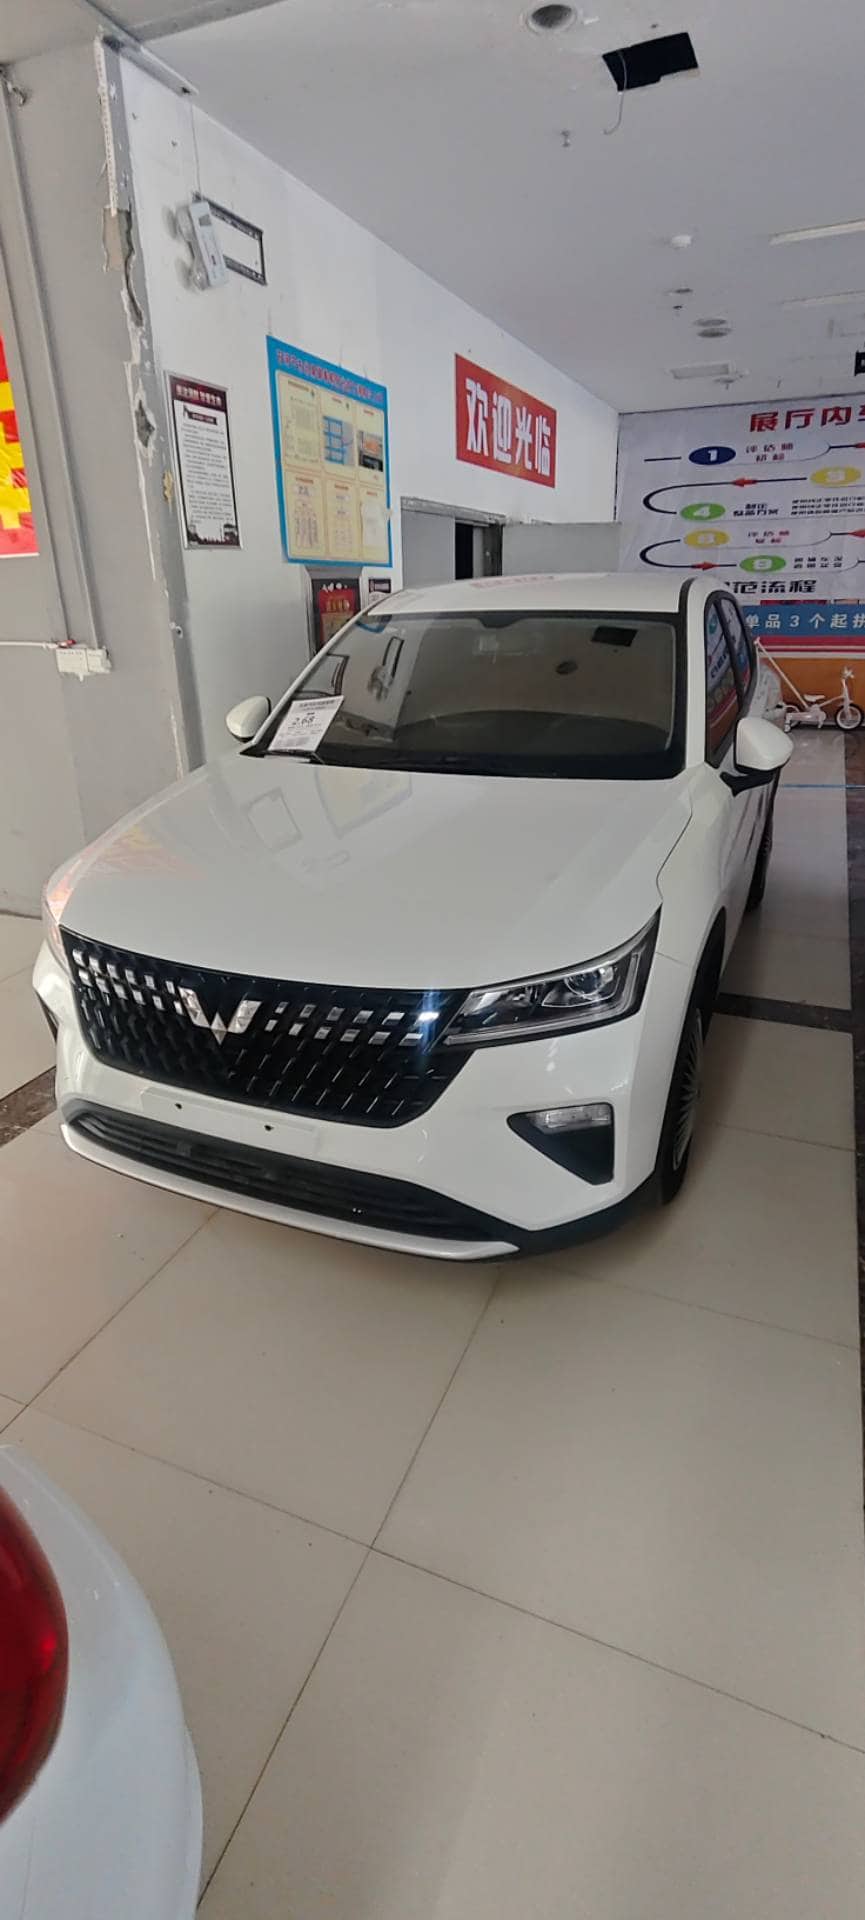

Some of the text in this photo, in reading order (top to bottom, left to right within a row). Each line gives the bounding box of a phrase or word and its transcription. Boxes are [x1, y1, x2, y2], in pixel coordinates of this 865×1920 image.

[750, 405, 865, 432] 展厅内
[465, 377, 551, 477] 欢迎光临
[707, 450, 718, 461] 1
[693, 505, 711, 517] 4
[724, 580, 817, 594] 范流程
